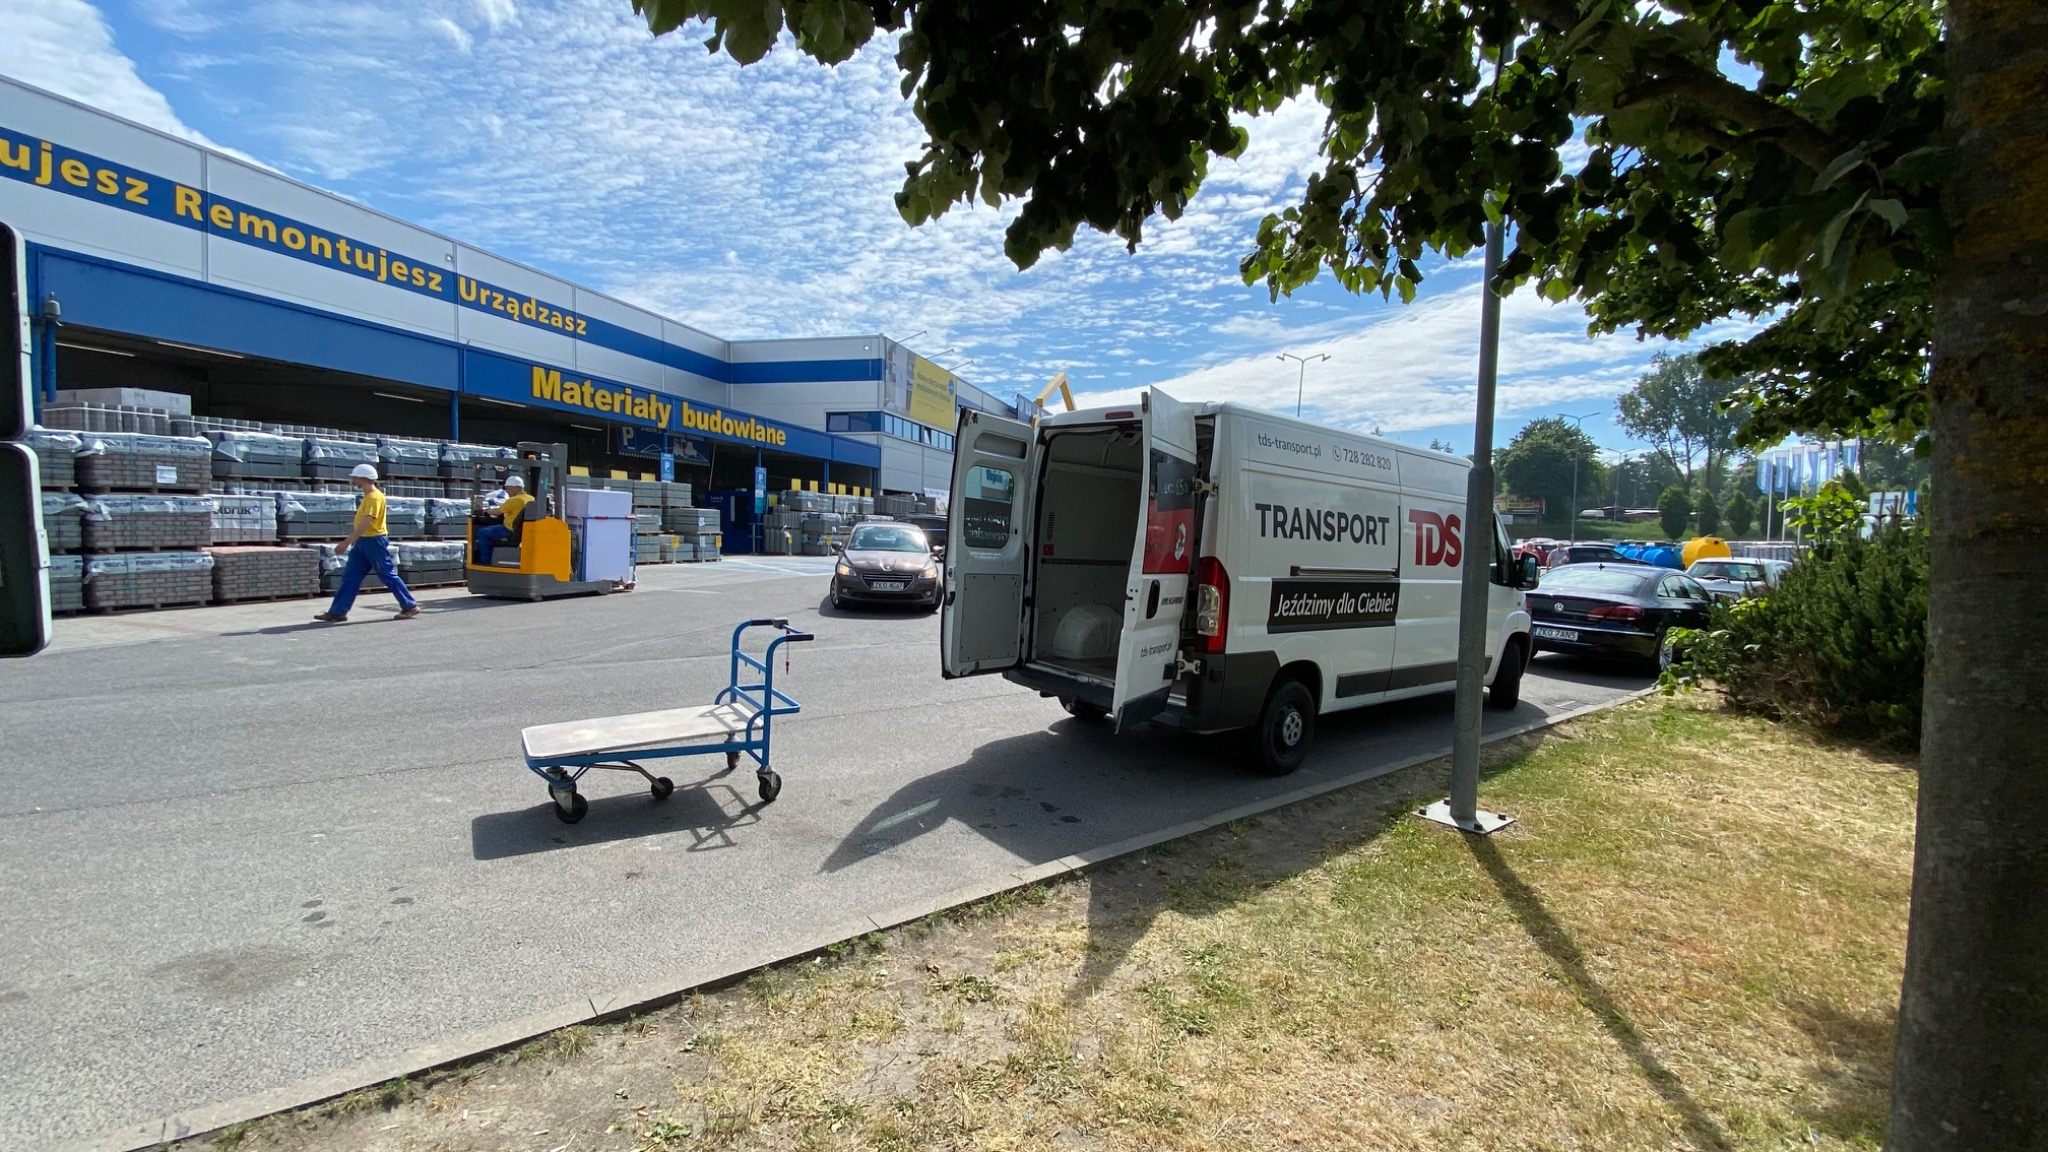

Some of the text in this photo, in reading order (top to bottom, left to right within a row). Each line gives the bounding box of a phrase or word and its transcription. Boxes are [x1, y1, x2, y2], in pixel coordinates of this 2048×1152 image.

[175, 185, 442, 292] Remontujesz
[459, 276, 587, 335] Urządzasz
[532, 366, 787, 446] Materiały budowlane
[1258, 433, 1392, 471] tds-transport.pl 728 282 820
[1255, 503, 1390, 546] TRANSPORT
[1408, 508, 1462, 568] TDS
[1274, 591, 1396, 619] Jeździmy dla Ciebie!
[1537, 627, 1553, 637] ZKO
